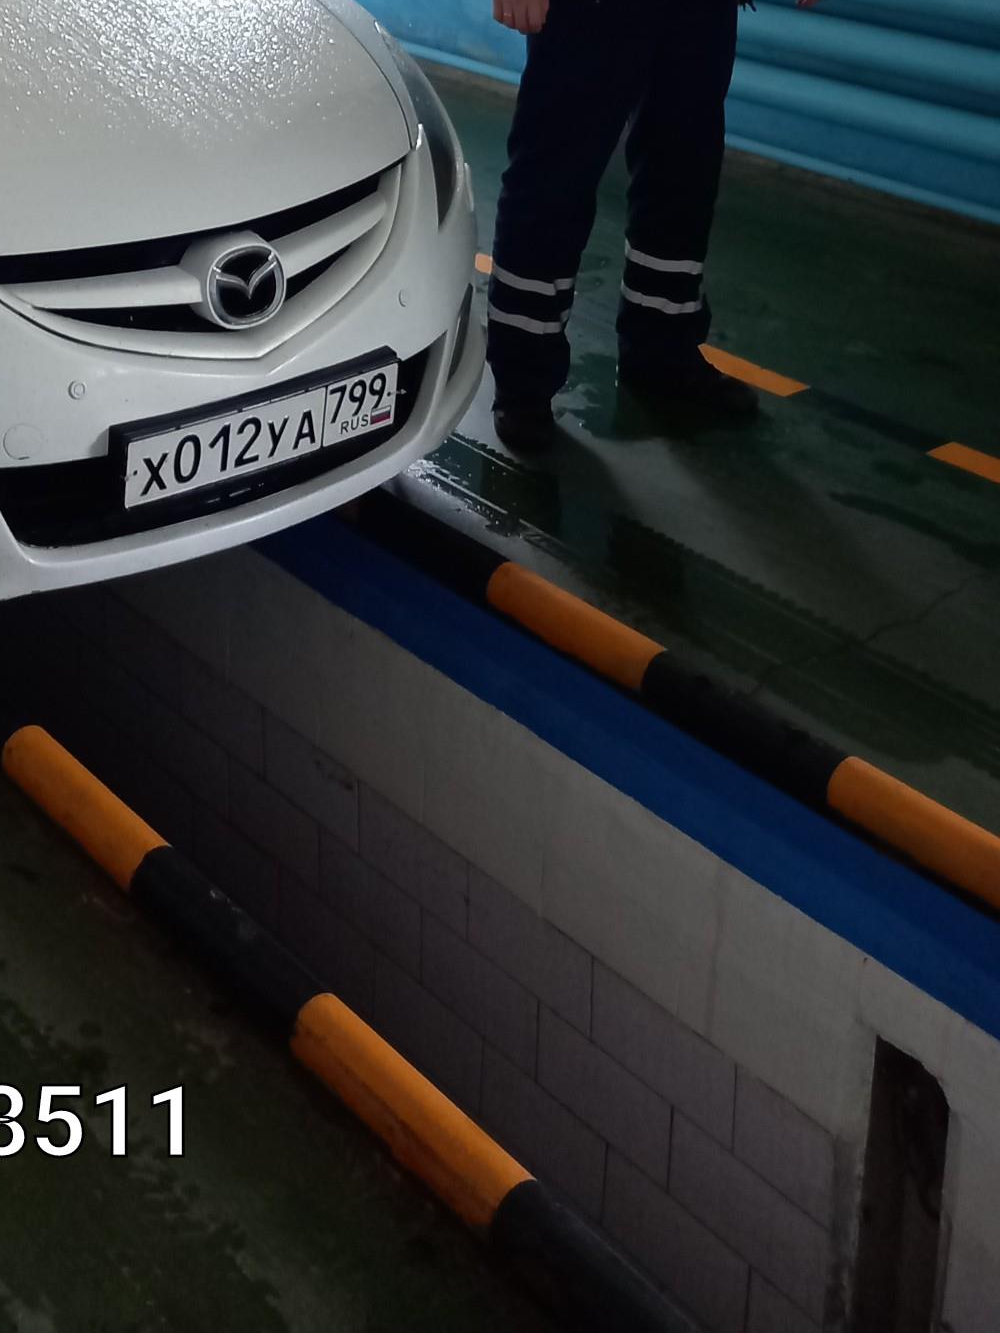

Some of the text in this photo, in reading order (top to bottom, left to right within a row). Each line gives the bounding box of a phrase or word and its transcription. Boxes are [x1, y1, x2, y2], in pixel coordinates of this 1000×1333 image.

[140, 372, 387, 496] Х012УА 799
[340, 416, 369, 435] RUS
